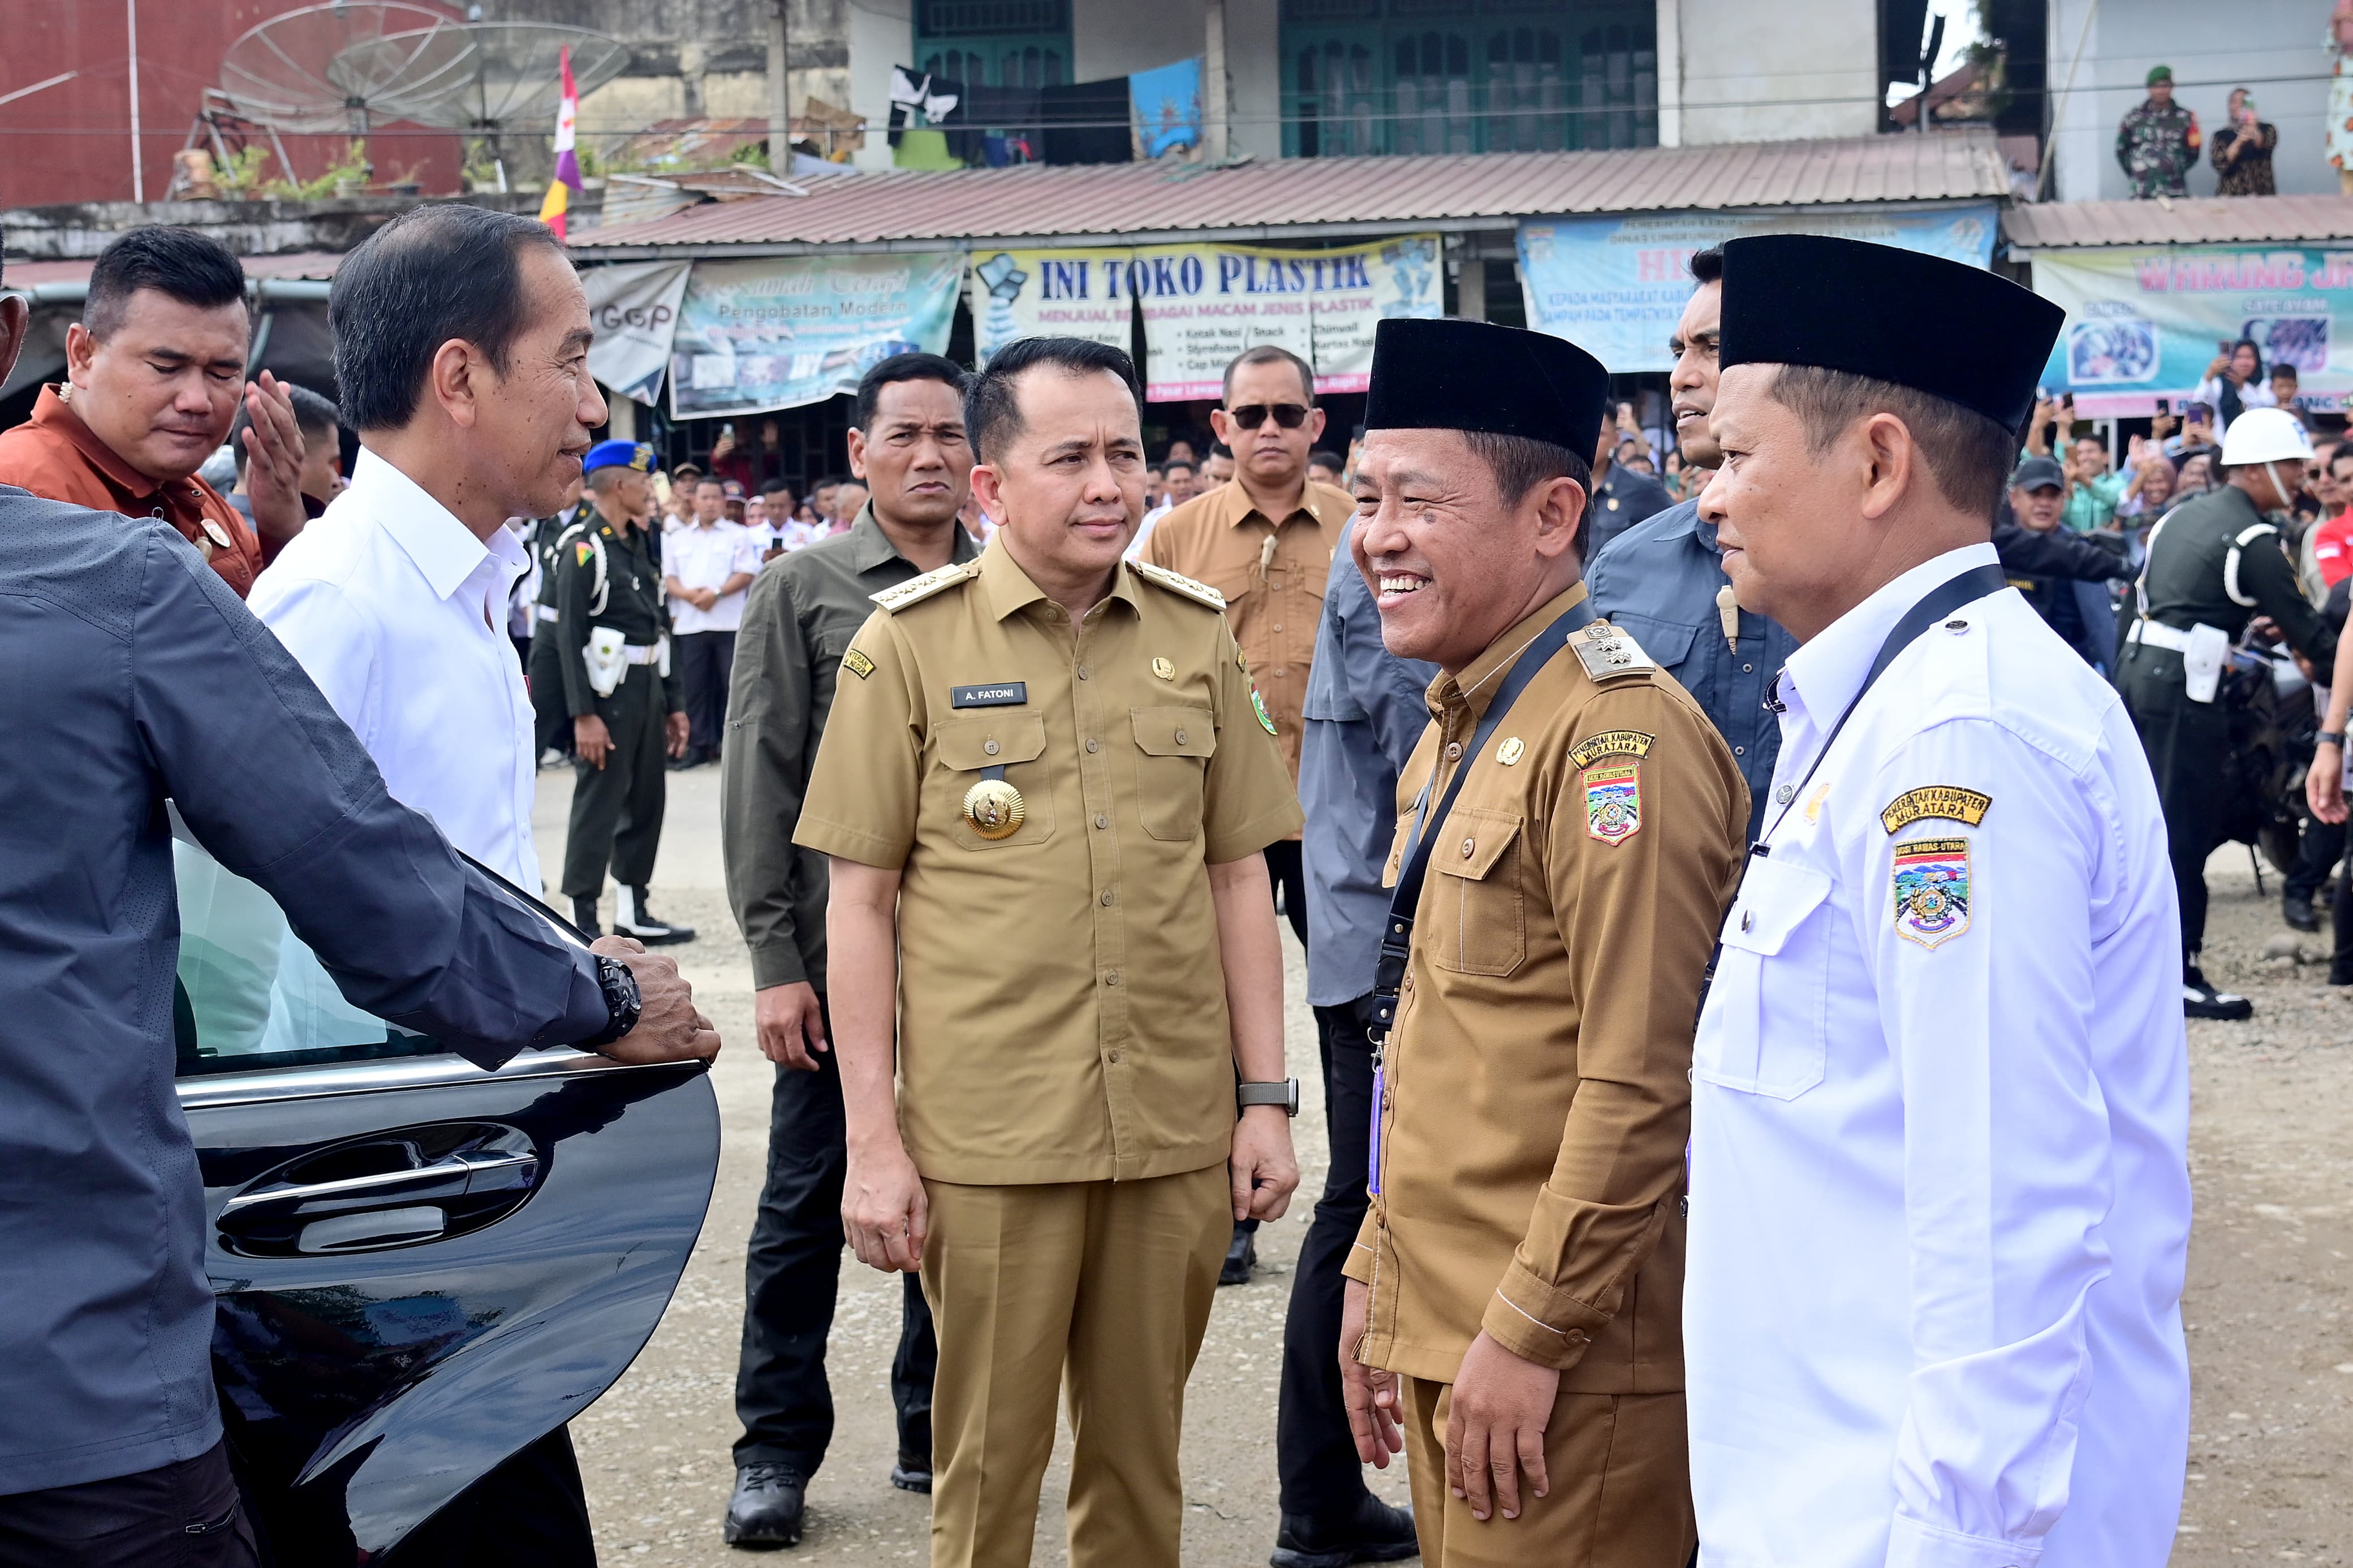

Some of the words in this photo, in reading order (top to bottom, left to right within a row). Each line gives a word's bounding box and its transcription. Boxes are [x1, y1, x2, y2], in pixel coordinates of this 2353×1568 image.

[1040, 260, 1089, 301] INI
[1102, 254, 1204, 301] TOKO
[1217, 253, 1371, 295] PLASTIK
[2132, 251, 2306, 292] WARUNG
[719, 303, 833, 323] Pengobatan
[841, 301, 908, 317] Modern
[1039, 309, 1110, 322] MENJUAL
[1198, 303, 1256, 317] MACAM
[1261, 301, 1304, 316] JENIS
[1310, 298, 1373, 314] PLASTIK
[1219, 327, 1240, 337] Nasi
[1253, 326, 1285, 337] Snack
[965, 692, 976, 701] A.
[977, 689, 1014, 699] FATONI
[1611, 732, 1649, 746] KABUPATEN
[1583, 742, 1637, 761] MURATARA
[1896, 802, 1965, 824] MURATARA
